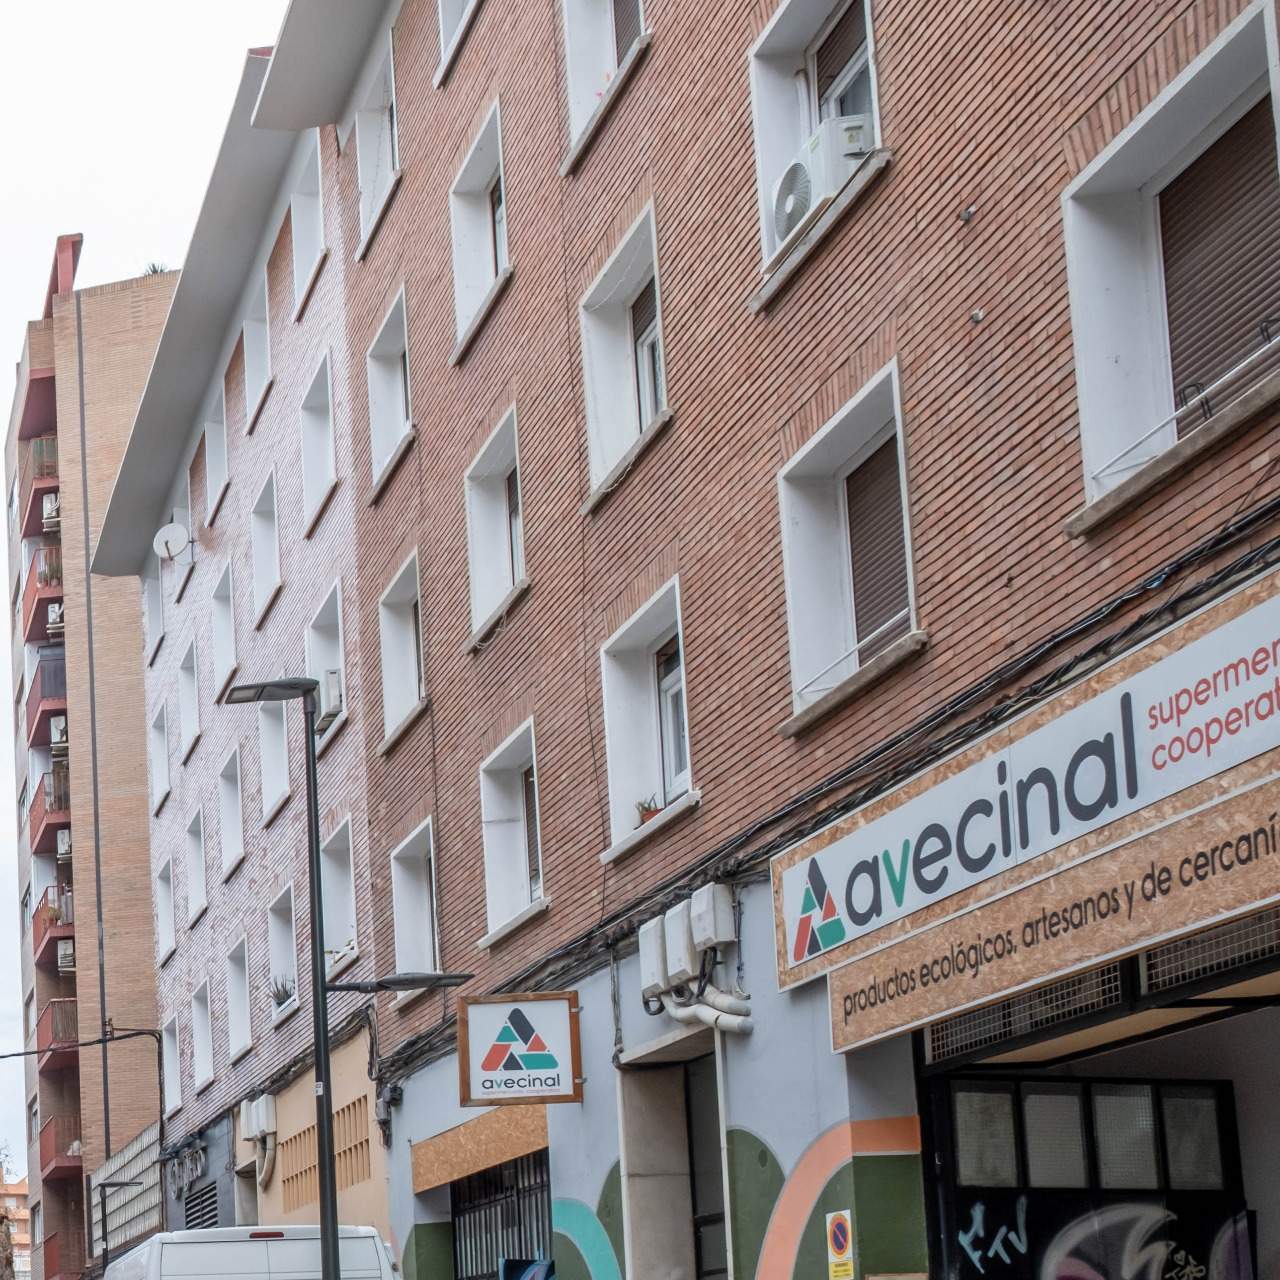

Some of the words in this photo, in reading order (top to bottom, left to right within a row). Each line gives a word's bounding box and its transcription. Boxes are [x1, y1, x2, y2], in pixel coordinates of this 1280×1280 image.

[845, 691, 1139, 927] avecinal
[843, 966, 916, 1025] productos
[919, 932, 1017, 987] ecológicos,
[1022, 886, 1120, 948] artesanos
[1124, 880, 1135, 920] y
[1142, 861, 1172, 901] de
[1179, 812, 1280, 887] cercaní
[481, 1073, 561, 1090] avecinal
